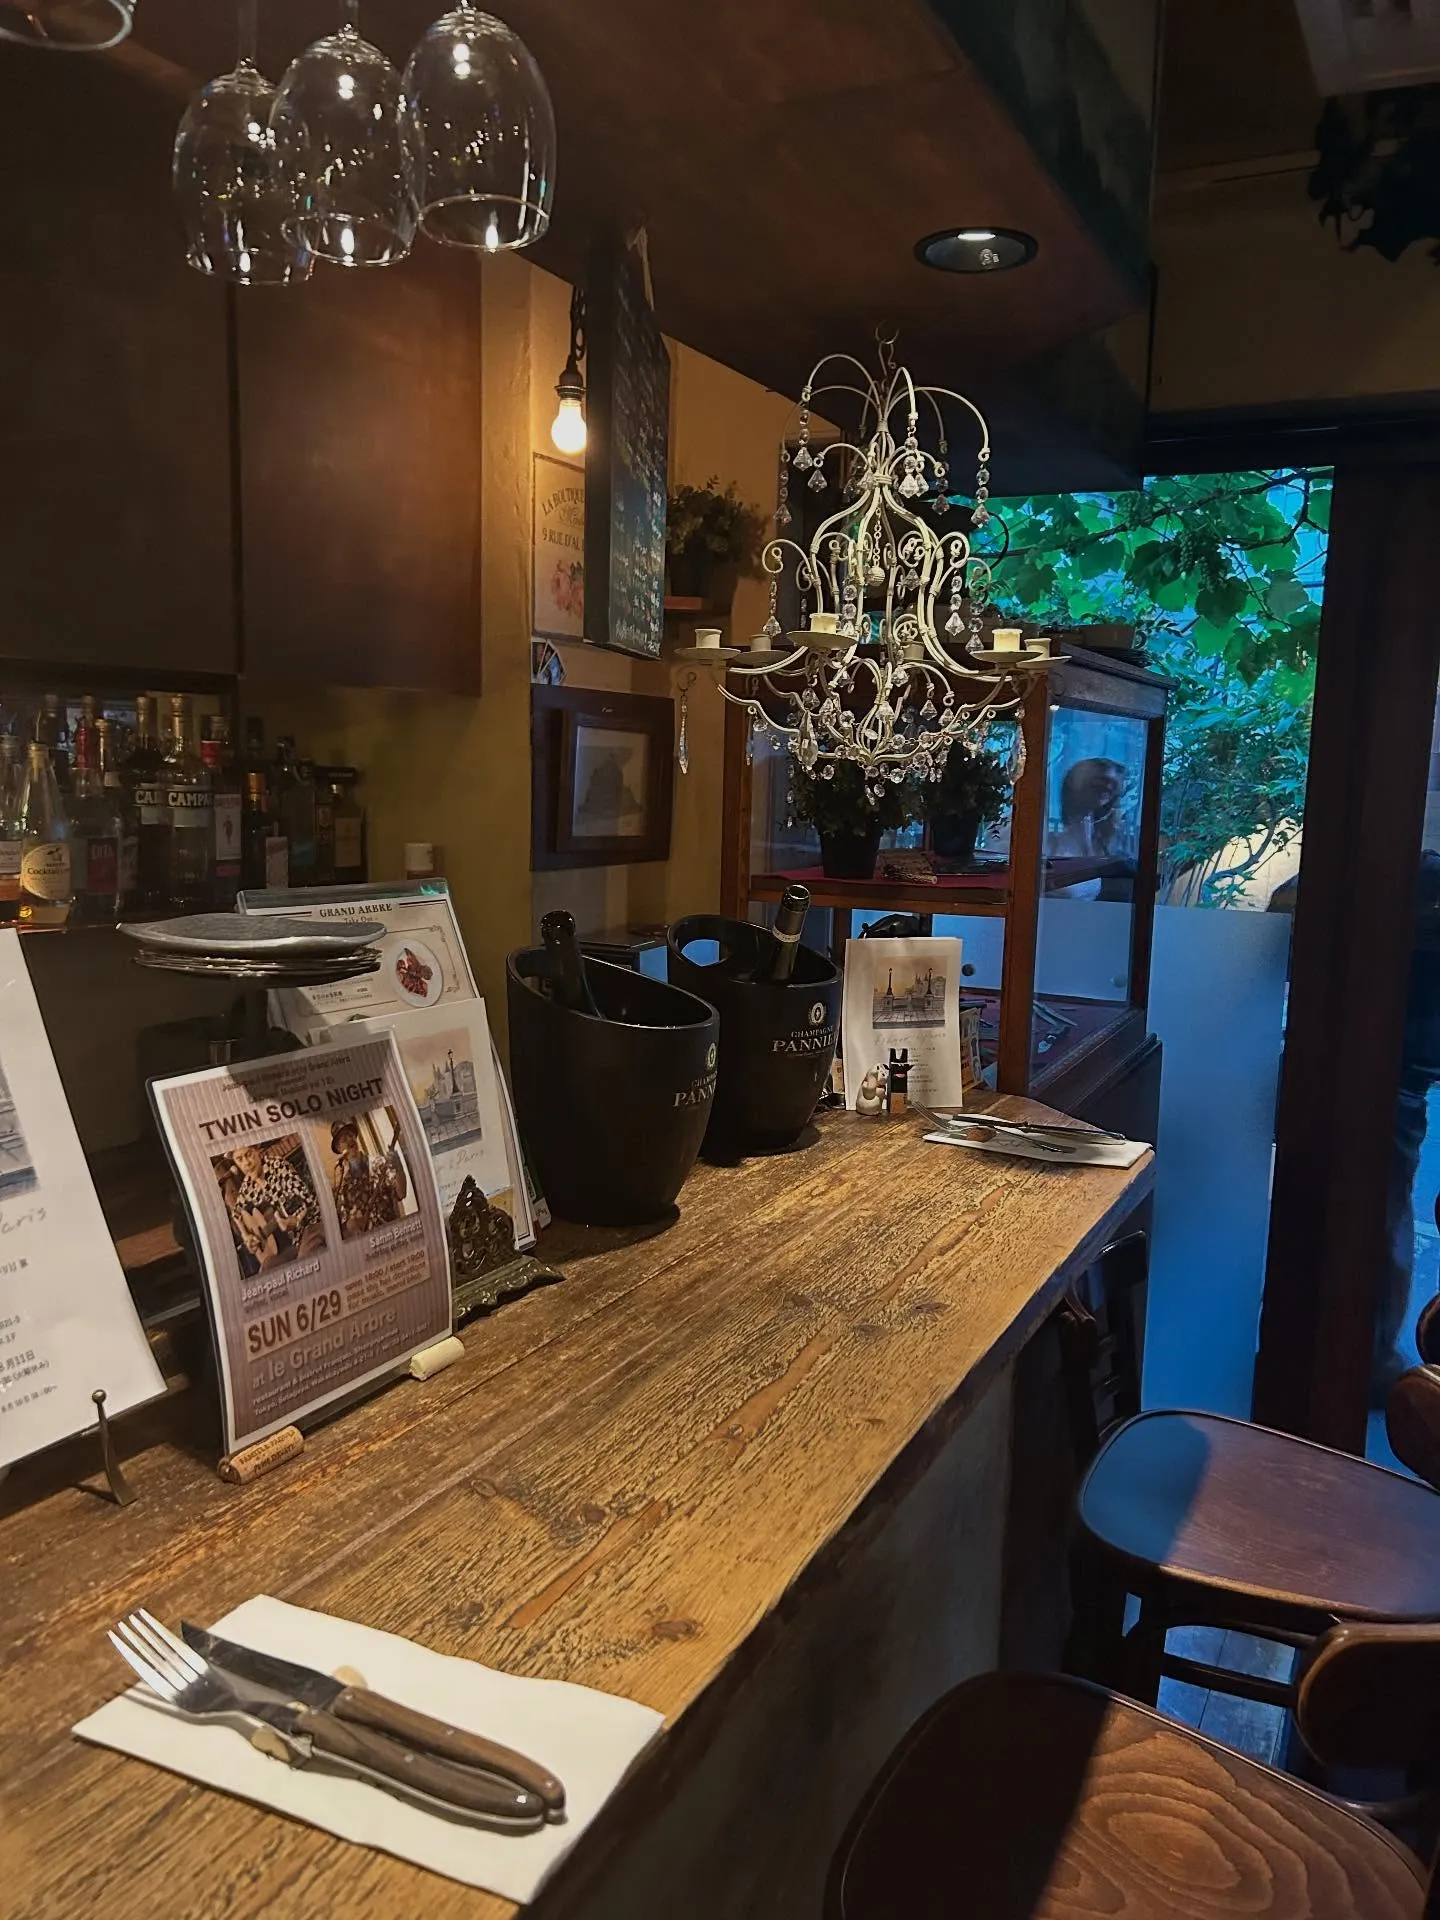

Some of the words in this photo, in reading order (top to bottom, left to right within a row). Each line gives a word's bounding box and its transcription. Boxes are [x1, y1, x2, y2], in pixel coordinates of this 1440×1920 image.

[168, 791, 213, 808] CAMPA
[319, 906, 355, 918] GRAND
[358, 903, 393, 914] ARBRE
[772, 1034, 835, 1053] PANNIE
[673, 1080, 717, 1108] PANN
[198, 1109, 263, 1141] TWIN
[266, 1094, 323, 1123] SOLO
[326, 1078, 383, 1109] NIGHT
[0, 1207, 47, 1235] aris
[286, 1258, 321, 1282] Richard
[246, 1311, 292, 1355] SUN
[296, 1290, 342, 1332] 6/29
[268, 1361, 286, 1382] le
[289, 1331, 345, 1370] Grand
[350, 1308, 398, 1343] Arbre
